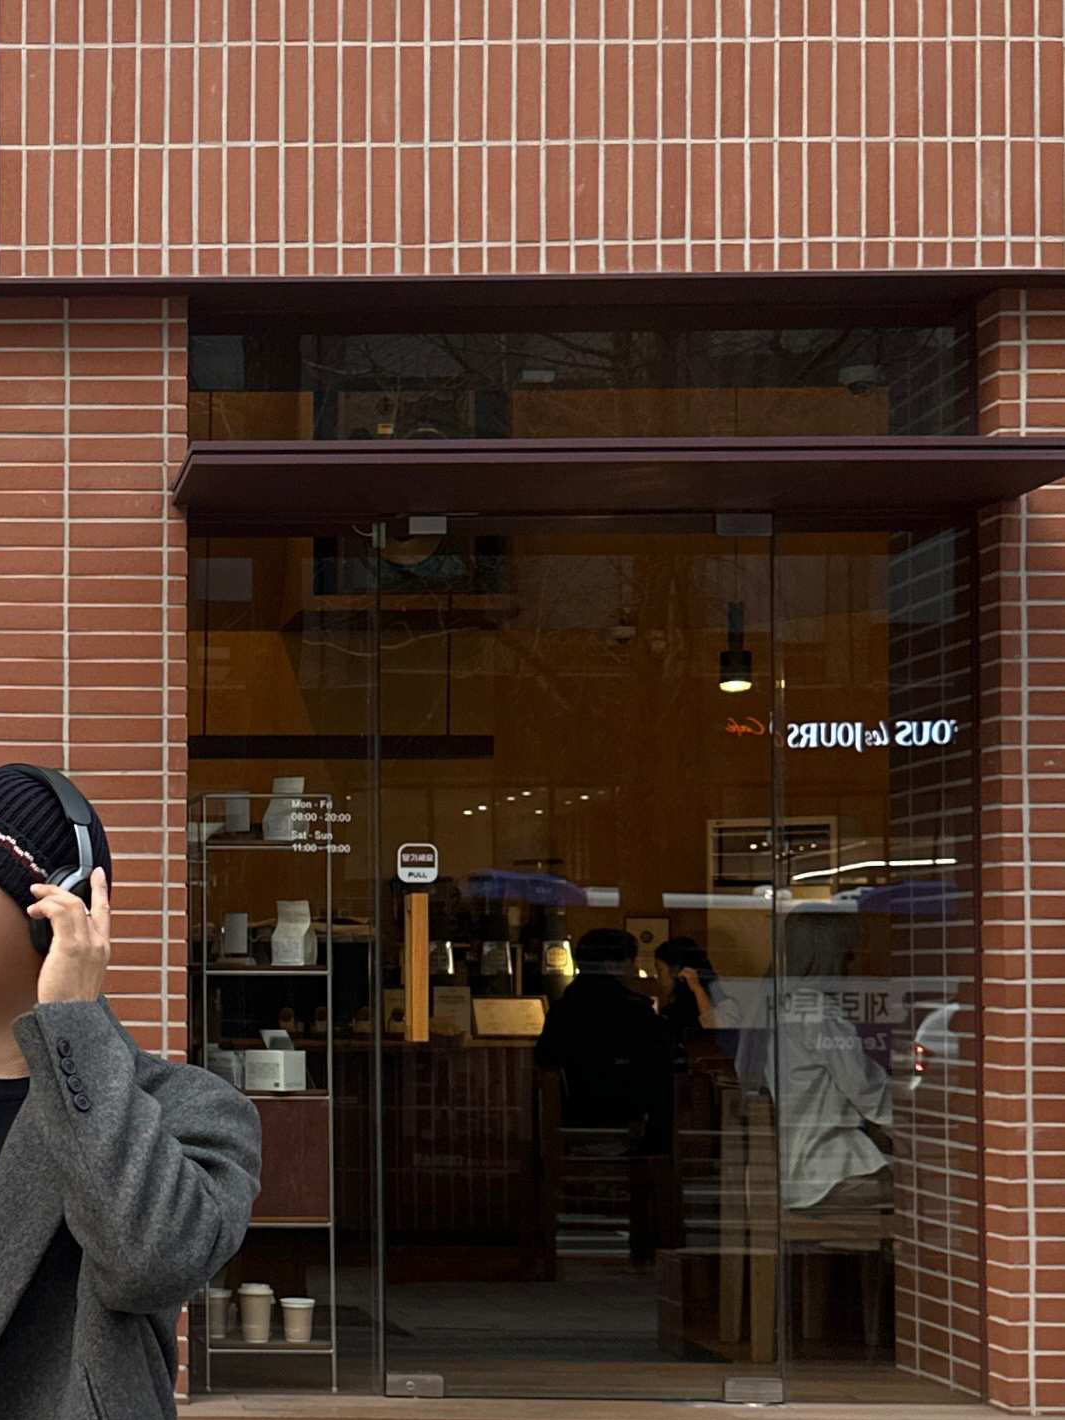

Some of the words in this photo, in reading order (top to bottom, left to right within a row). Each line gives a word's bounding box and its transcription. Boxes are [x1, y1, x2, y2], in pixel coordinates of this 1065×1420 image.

[291, 799, 312, 809] Mon
[320, 800, 333, 809] Fri
[291, 813, 317, 822] 08:00
[324, 813, 351, 822] 20:00
[291, 830, 307, 840] Sat
[314, 831, 333, 840] Sun
[292, 843, 317, 852] 11:00
